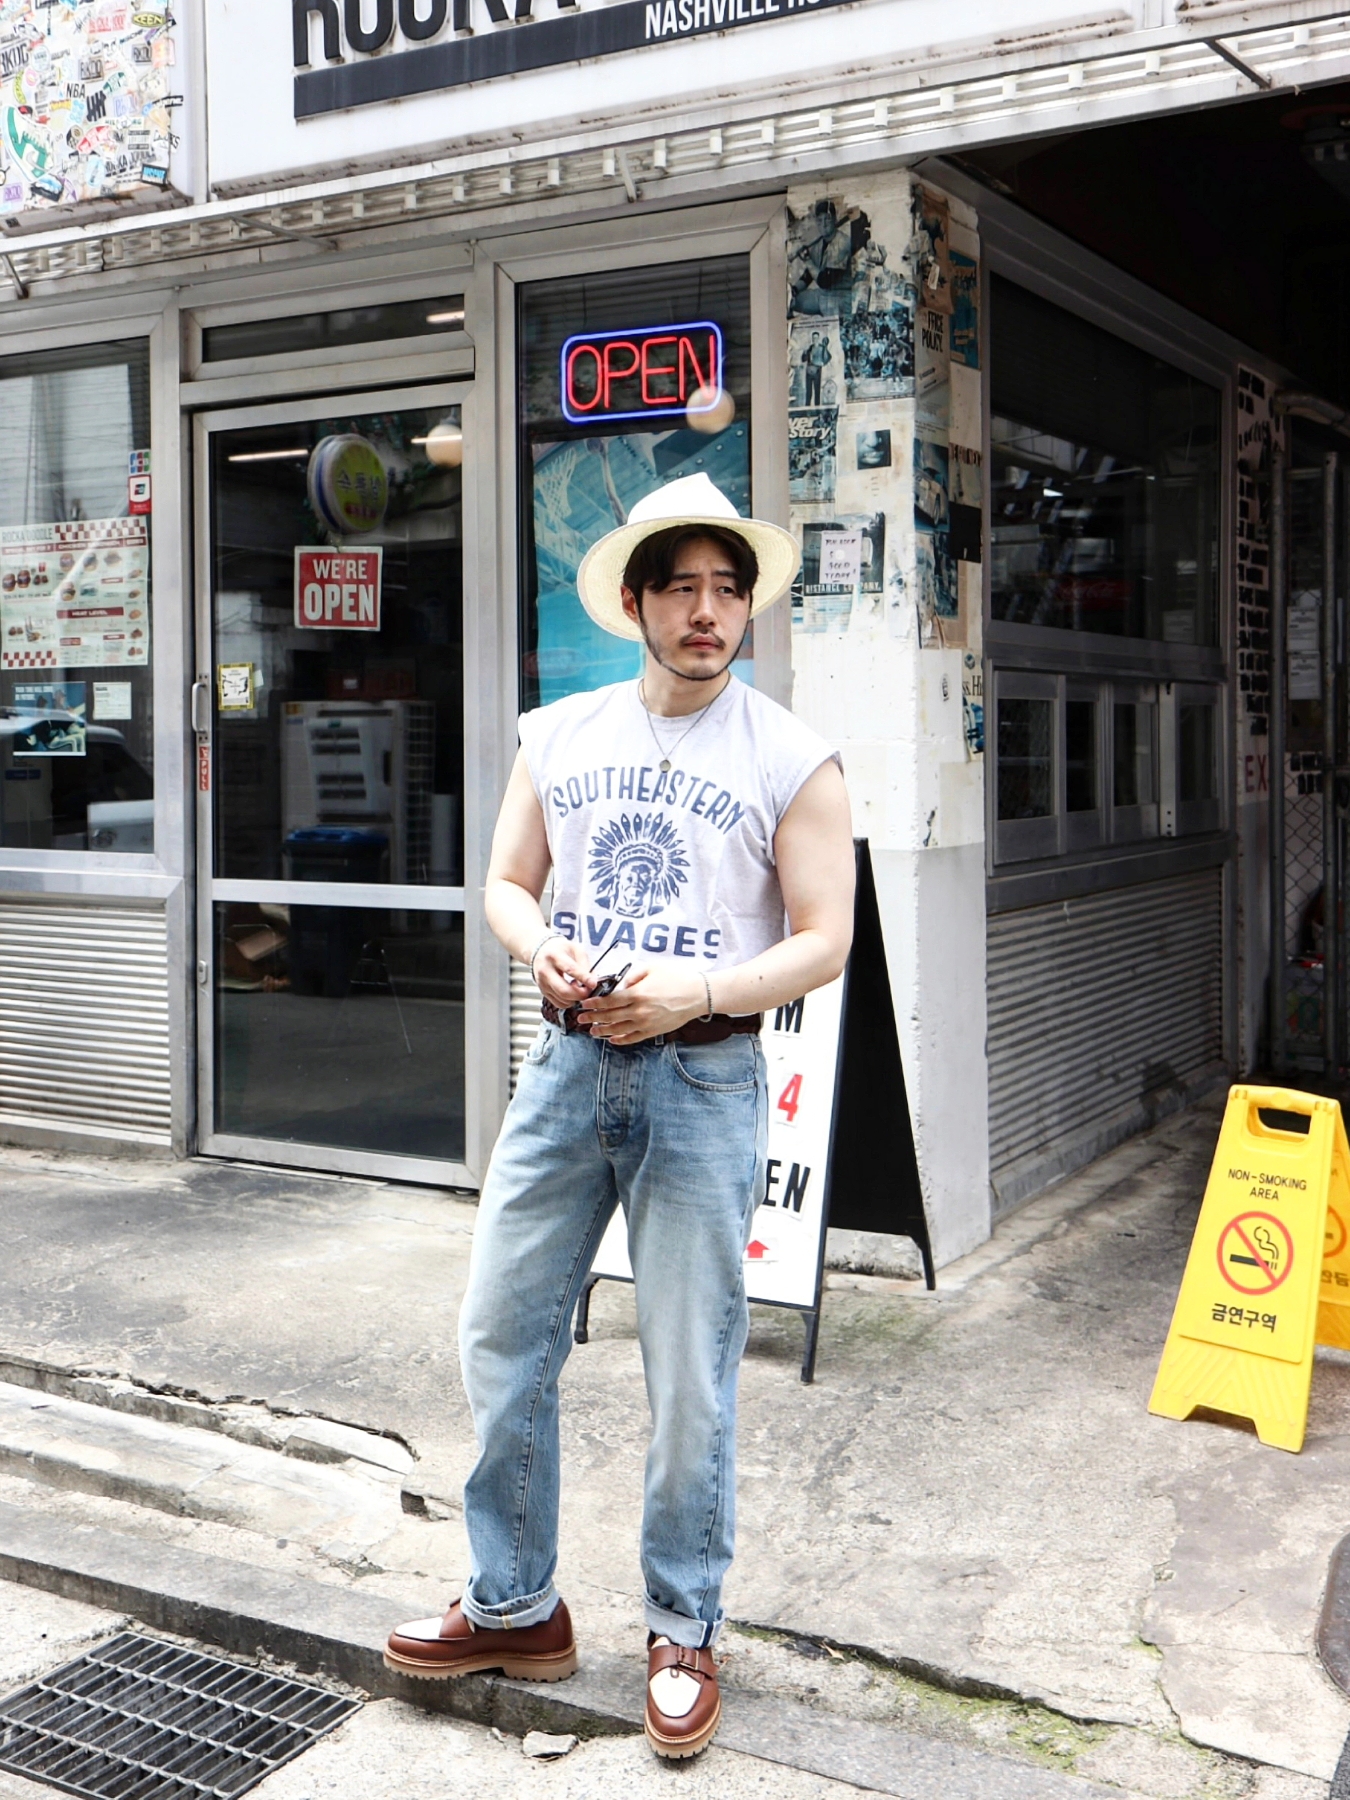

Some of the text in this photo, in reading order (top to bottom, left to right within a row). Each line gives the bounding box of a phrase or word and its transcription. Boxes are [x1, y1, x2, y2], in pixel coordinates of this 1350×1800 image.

[134, 14, 164, 25] KEEN
[66, 82, 86, 98] NBA
[567, 335, 717, 411] OPEN
[789, 427, 831, 440] Story
[313, 559, 368, 579] WE'RE
[304, 583, 375, 622] OPEN
[553, 767, 746, 836] SOUTHEASTERN
[553, 911, 721, 959] SVAGES
[777, 1073, 803, 1122] 4
[1249, 1186, 1279, 1201] AREA
[1211, 1302, 1277, 1333] 금연구역
